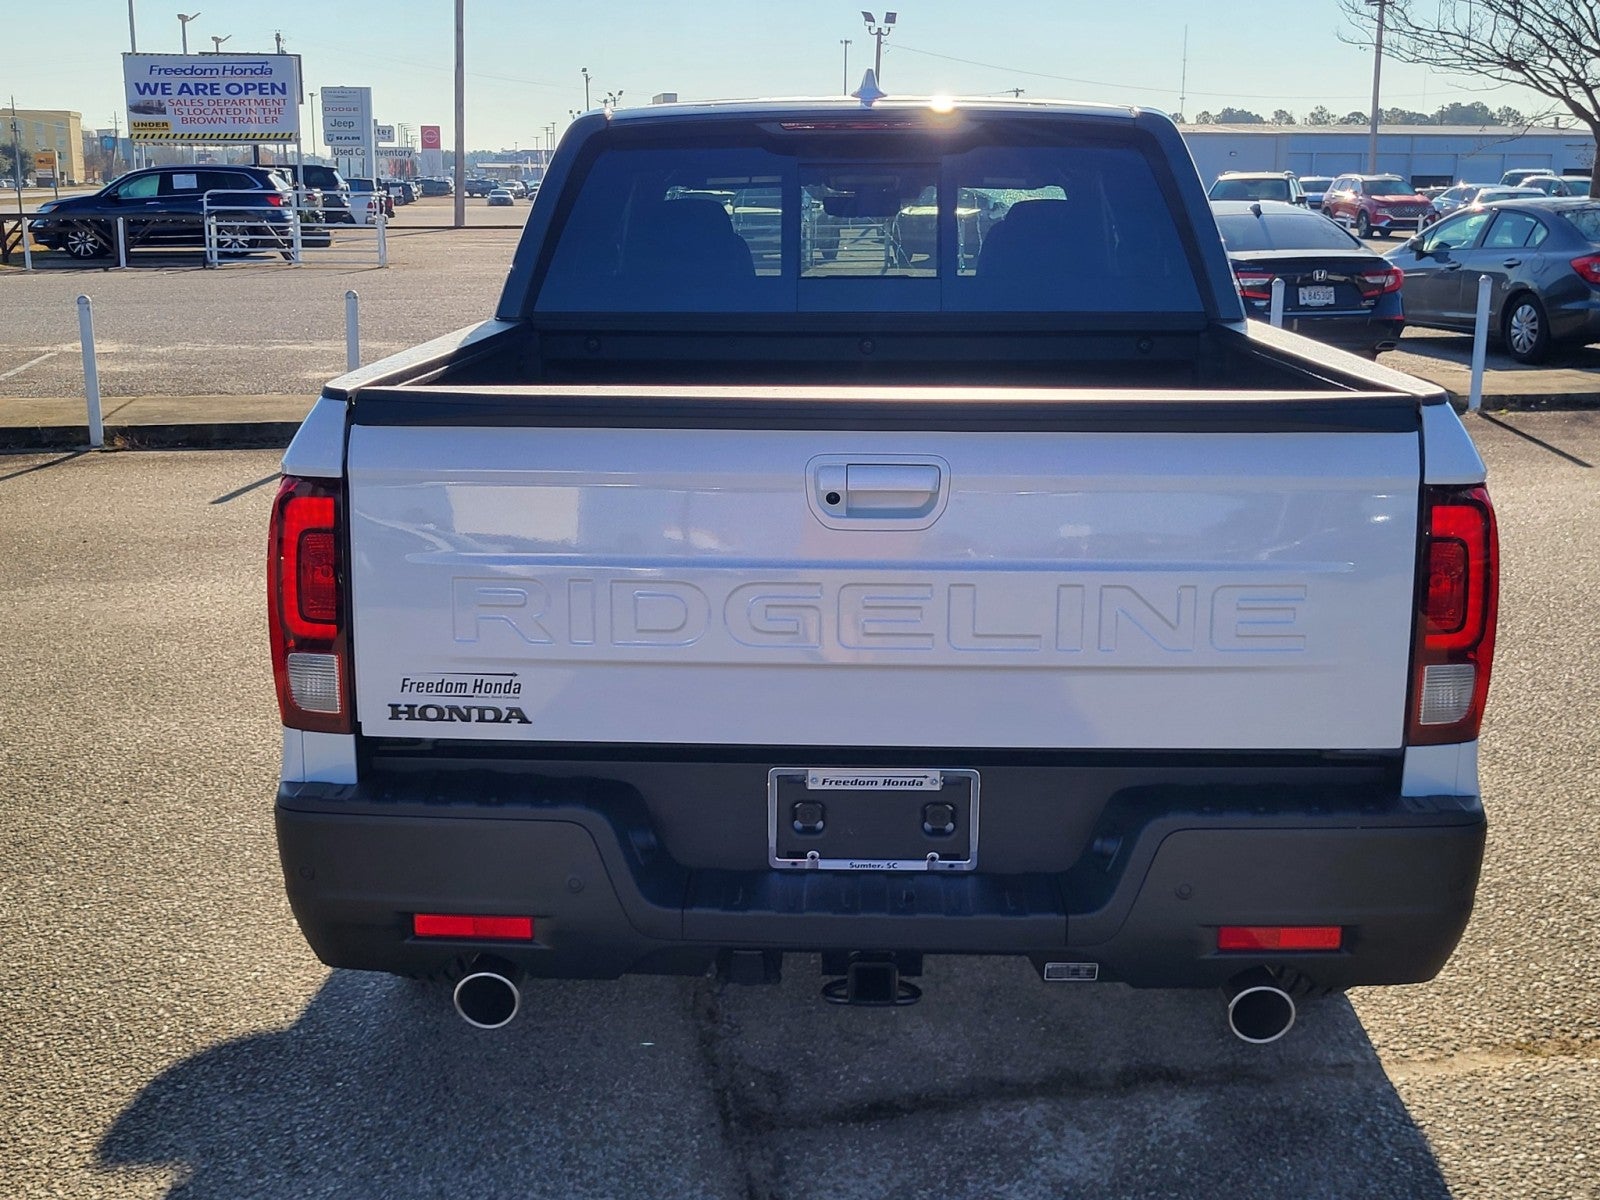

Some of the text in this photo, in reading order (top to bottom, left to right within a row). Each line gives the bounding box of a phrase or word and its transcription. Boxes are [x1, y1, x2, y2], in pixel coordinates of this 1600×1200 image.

[149, 64, 273, 76] Freedom Honda
[134, 82, 287, 96] WE ARE OPEN
[168, 98, 288, 107] SALES DEPARTMENT
[174, 107, 284, 116] IS LOCATED IN THE
[181, 116, 279, 125] BROWN TRAILER
[330, 118, 355, 129] Jeep
[377, 128, 392, 136] ter
[333, 147, 413, 158] Used Ca nventory
[451, 575, 1308, 653] RIDGELINE
[400, 677, 522, 695] Freedom Honda
[387, 703, 533, 724] HONDA
[821, 778, 924, 787] Freedom Honda
